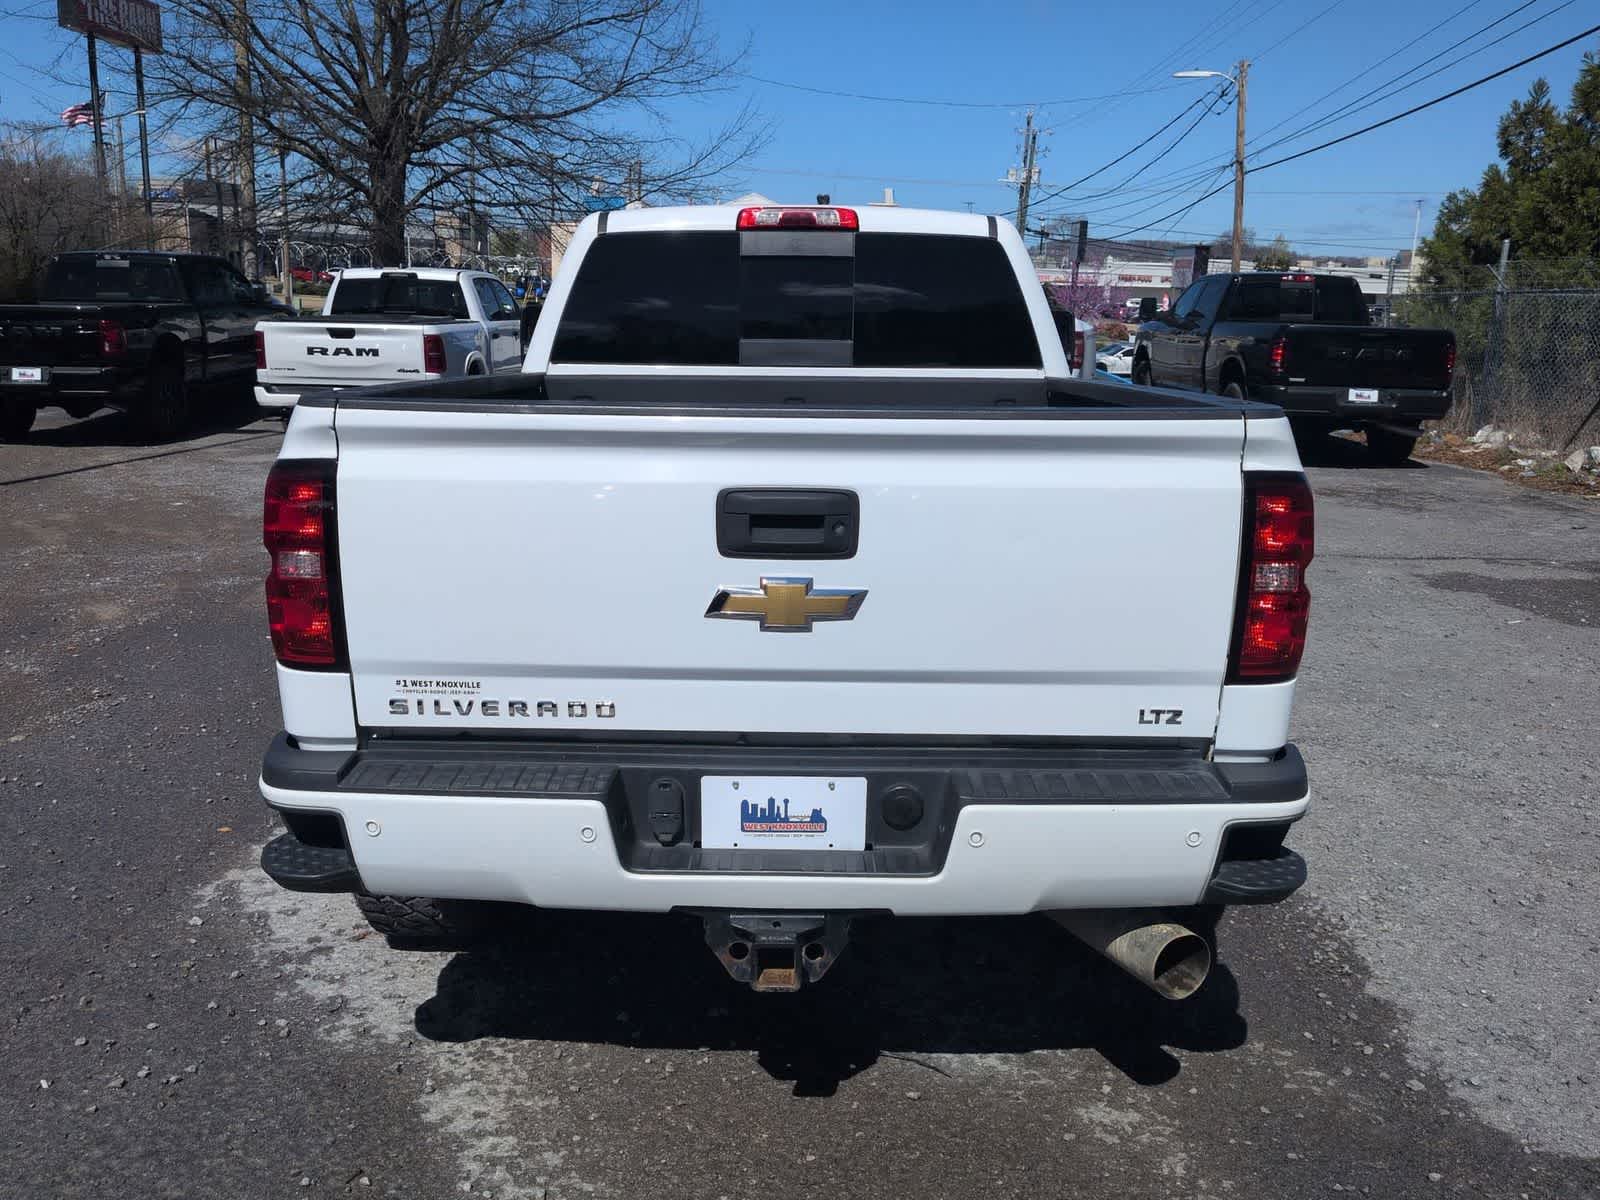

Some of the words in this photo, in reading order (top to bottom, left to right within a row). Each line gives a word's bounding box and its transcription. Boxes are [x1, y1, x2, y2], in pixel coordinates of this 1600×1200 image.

[306, 346, 380, 357] RAM
[395, 679, 408, 688] #1
[410, 680, 433, 688] WEST
[435, 680, 481, 689] KNOXVILLE
[388, 698, 616, 718] SILVERADO
[1138, 709, 1183, 725] LTZ
[743, 822, 770, 832] WEST
[771, 822, 825, 832] KNOXVILLE
